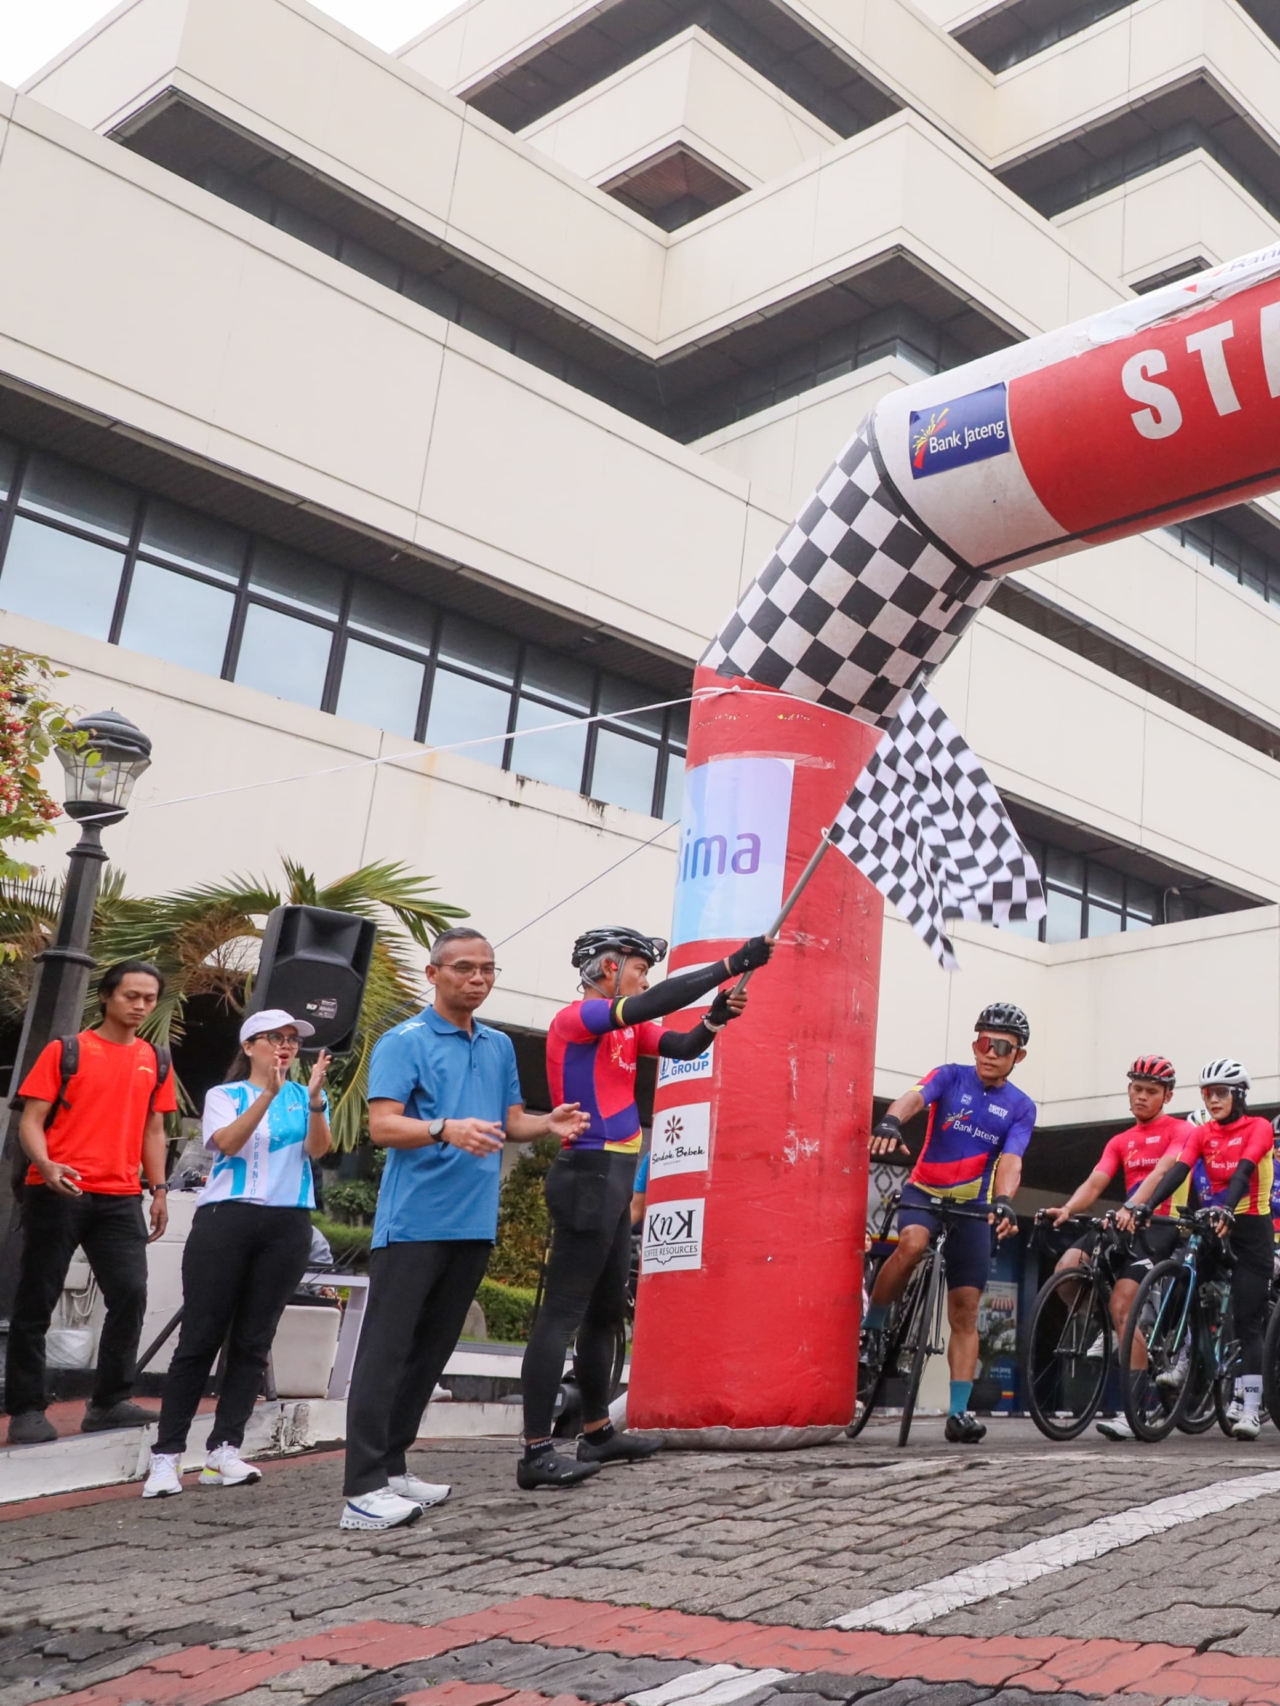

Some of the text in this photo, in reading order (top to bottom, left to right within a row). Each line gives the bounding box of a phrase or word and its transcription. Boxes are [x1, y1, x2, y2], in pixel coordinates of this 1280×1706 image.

[929, 420, 1005, 454] Bank Jateng
[677, 828, 761, 883] ima
[671, 1060, 709, 1075] GROUP
[953, 1120, 999, 1145] Bank Jateng
[675, 1145, 705, 1158] Bebek
[659, 1244, 698, 1256] RESOURCES
